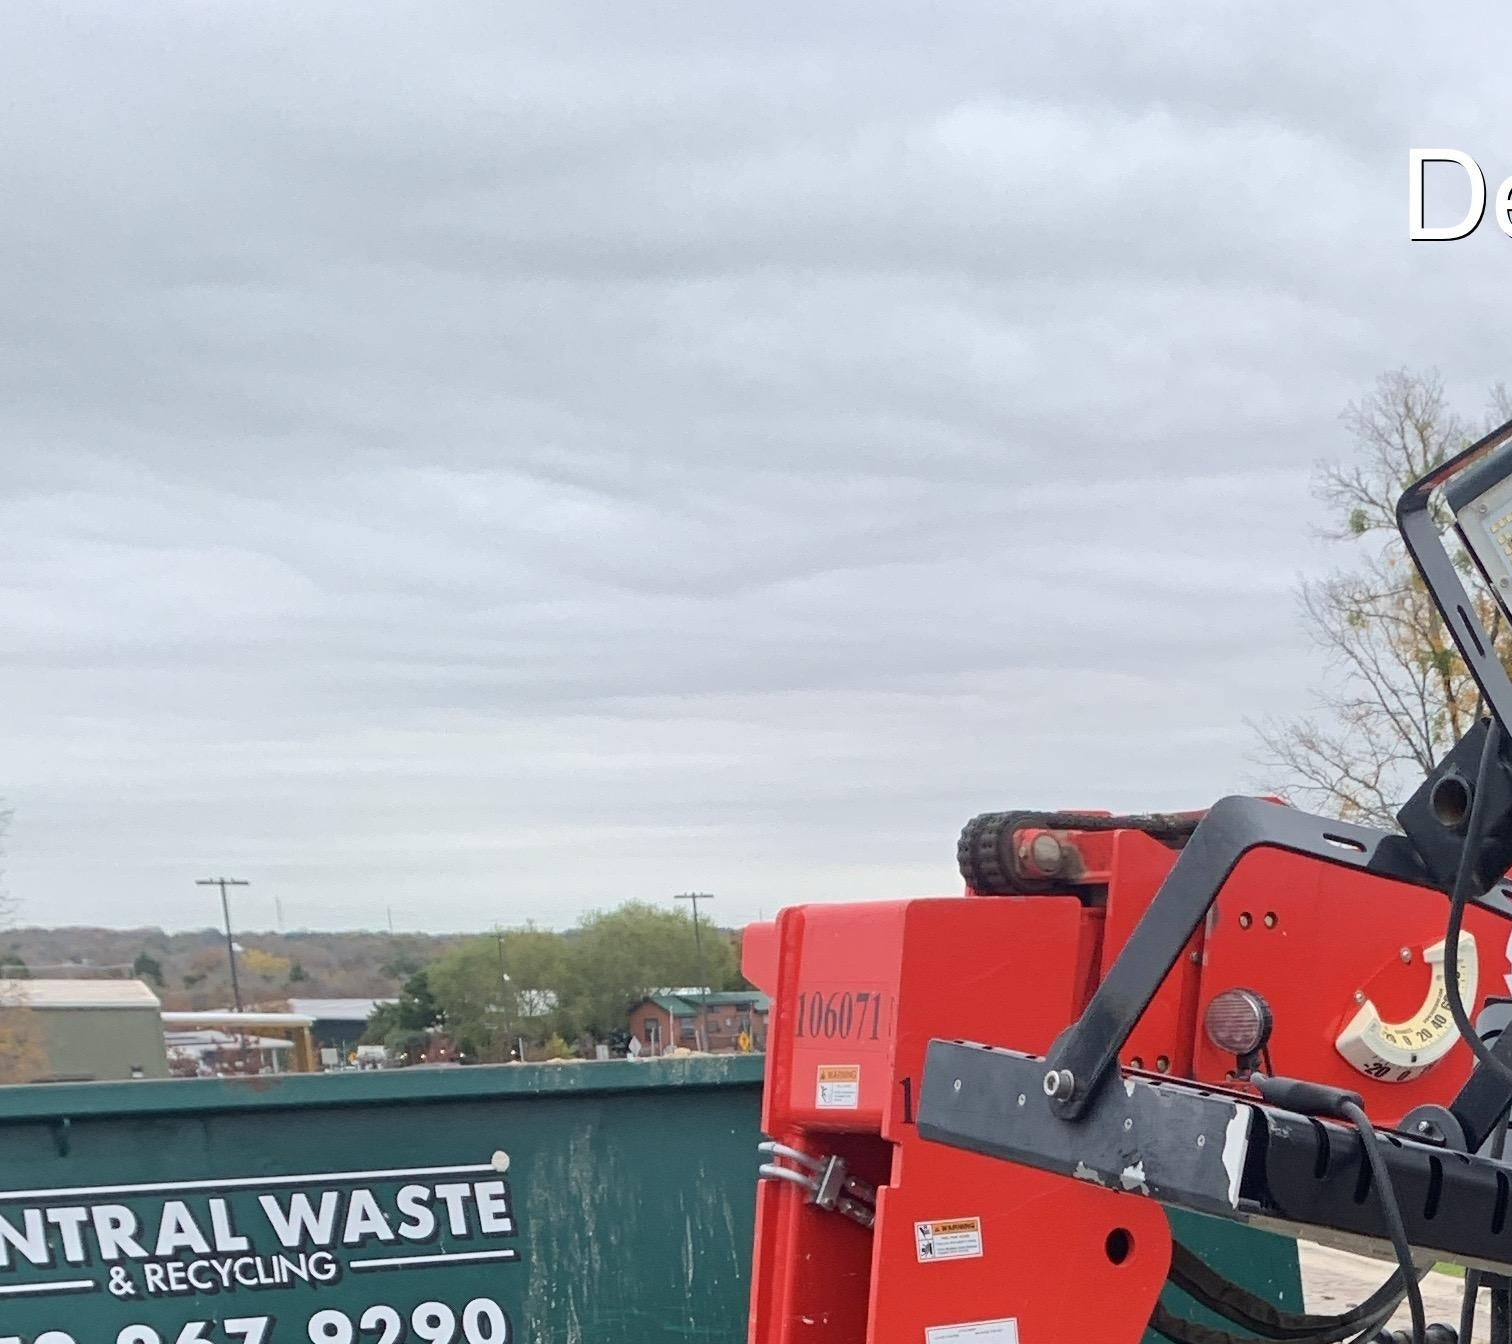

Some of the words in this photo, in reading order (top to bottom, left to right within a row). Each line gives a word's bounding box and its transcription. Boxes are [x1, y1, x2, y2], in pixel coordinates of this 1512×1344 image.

[796, 991, 882, 1040] 106071
[0, 1198, 249, 1267] NTRAL
[258, 1181, 512, 1248] WASTE
[108, 1266, 136, 1296] &
[144, 1251, 337, 1293] RECYCLING
